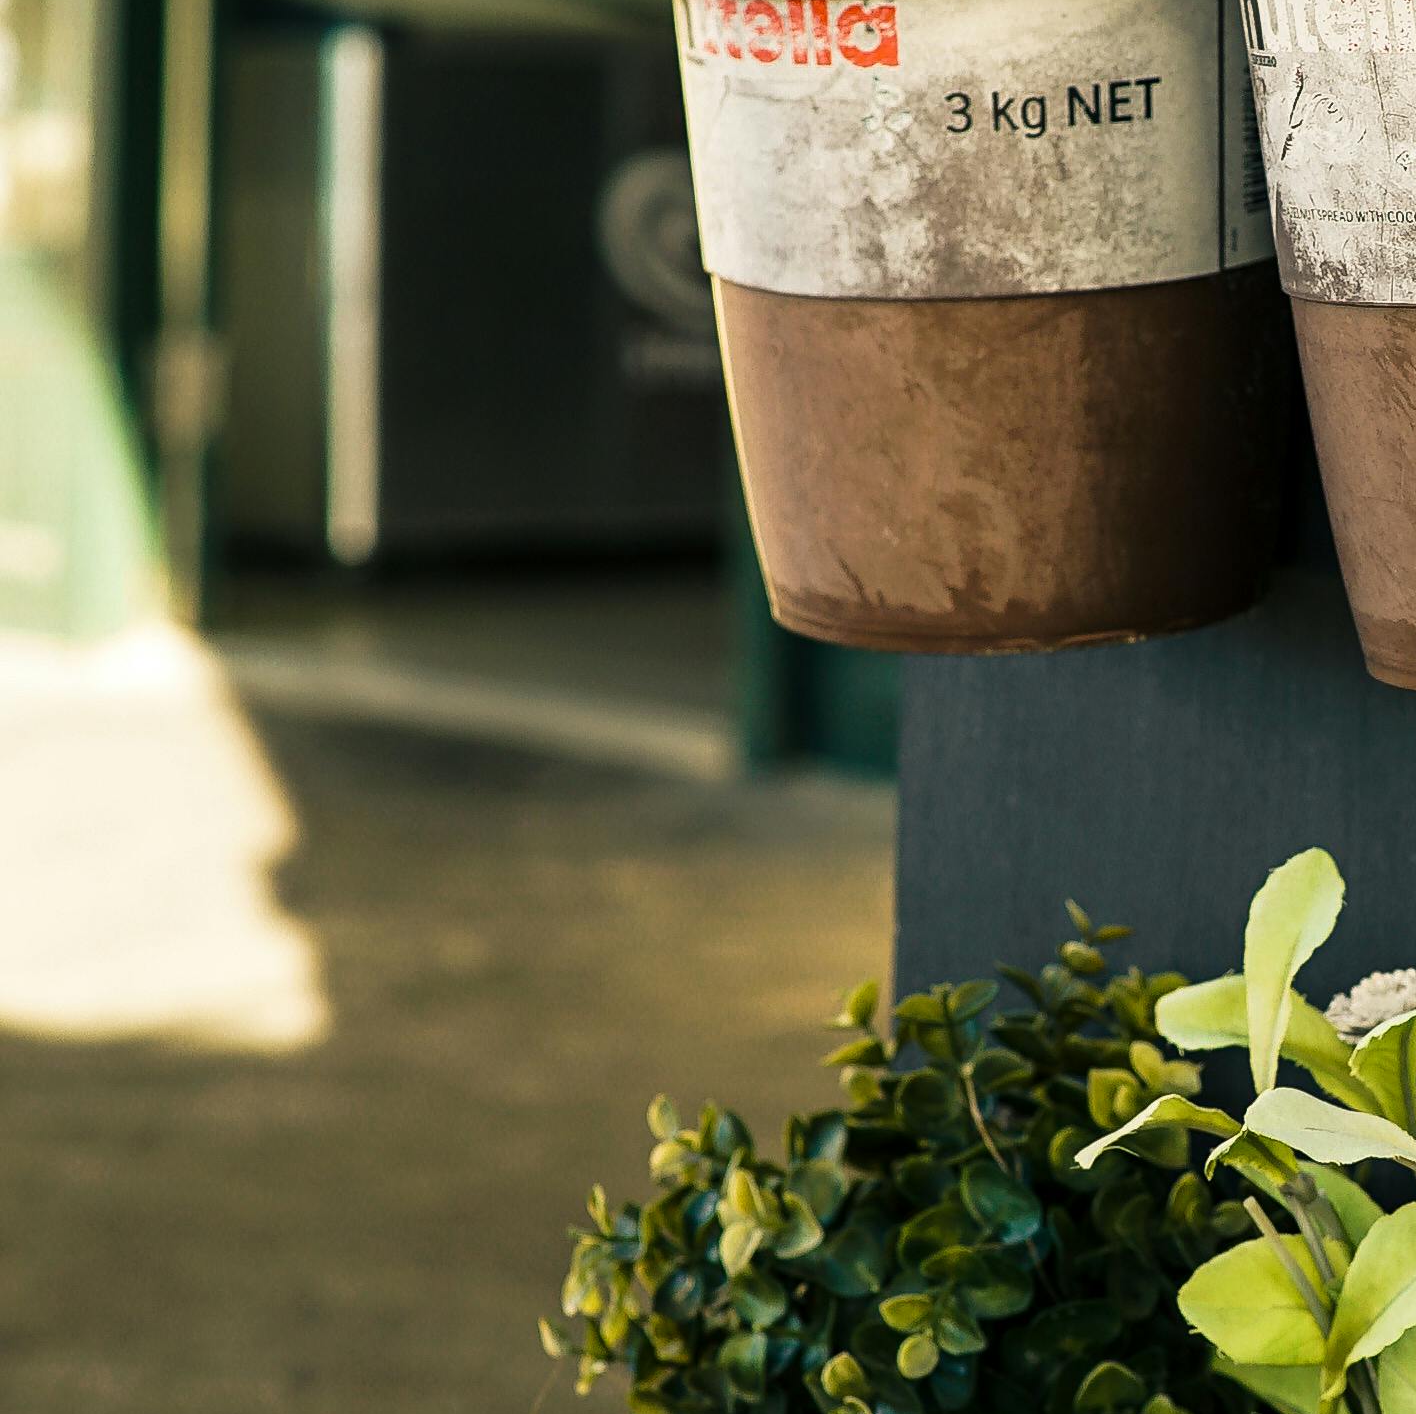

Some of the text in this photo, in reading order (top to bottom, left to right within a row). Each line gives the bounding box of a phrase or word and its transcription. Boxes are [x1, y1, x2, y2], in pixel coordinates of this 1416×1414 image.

[945, 77, 1162, 138] 3 kg NET
